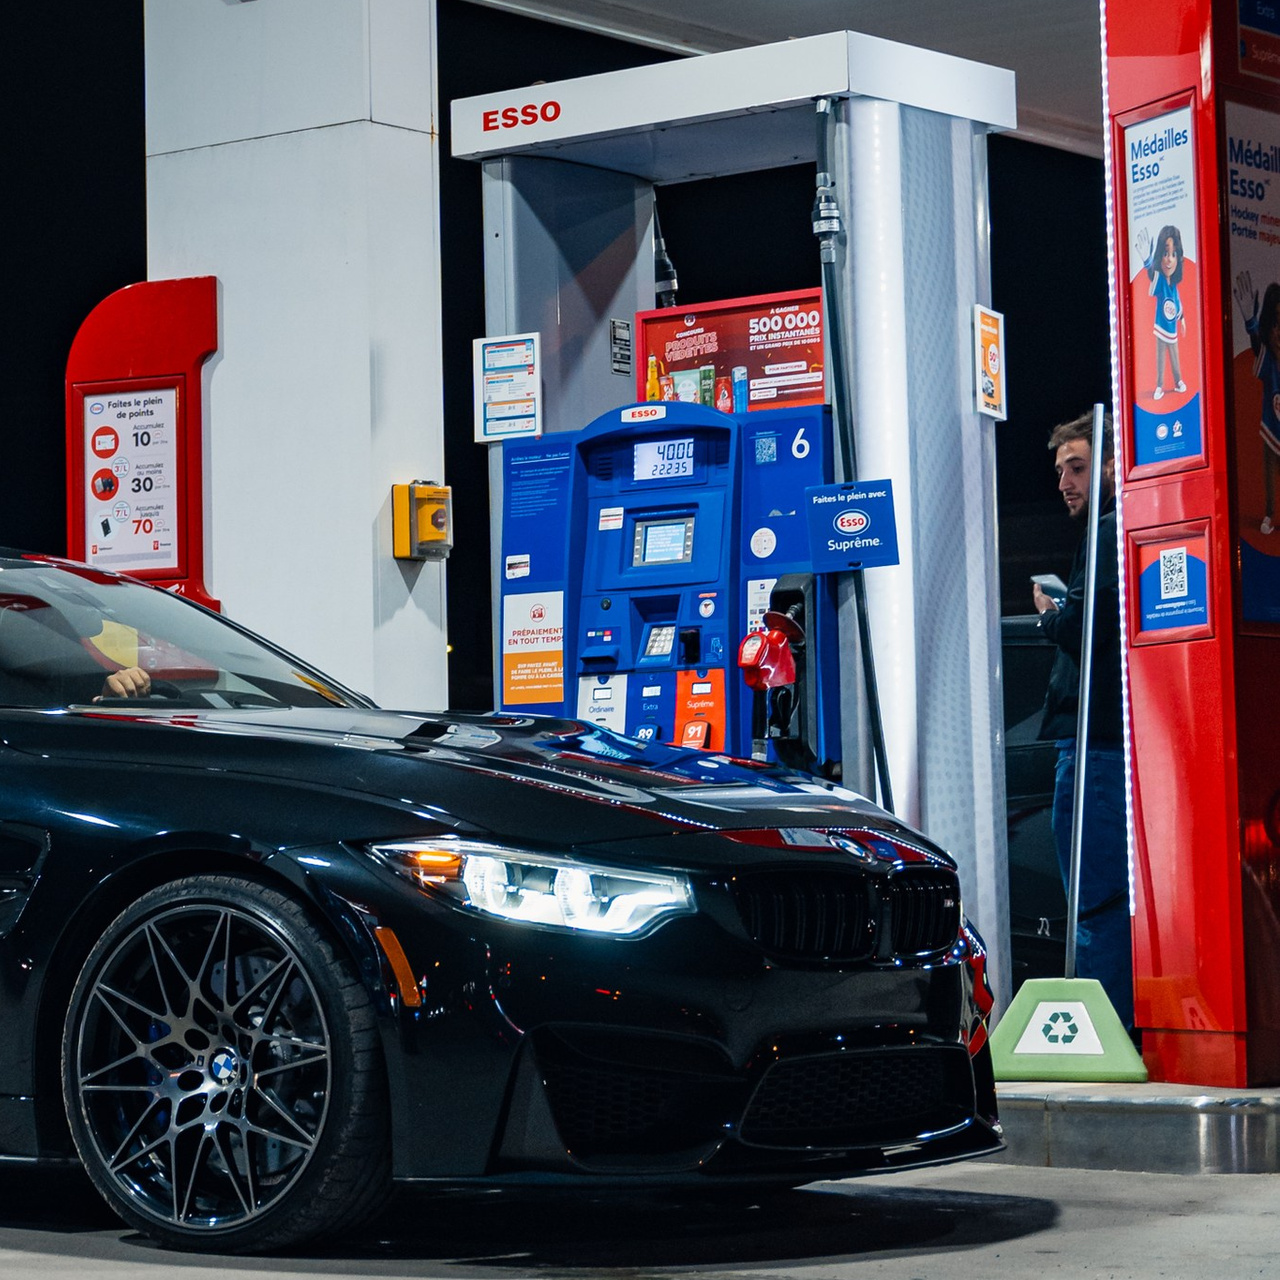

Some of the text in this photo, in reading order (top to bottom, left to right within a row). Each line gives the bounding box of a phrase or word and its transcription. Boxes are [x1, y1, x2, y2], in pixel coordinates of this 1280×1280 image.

[482, 100, 562, 132] ESSO
[1130, 127, 1189, 162] Médailles
[1132, 162, 1160, 184] Esso
[1230, 169, 1265, 202] Esso
[1230, 204, 1259, 226] Hockey
[1231, 222, 1258, 241] Portée
[749, 310, 820, 334] 500 000
[665, 332, 718, 353] PRODUITS
[749, 326, 820, 343] PRIX INSTANTANÉS
[664, 342, 719, 363] VEDETTES
[108, 400, 132, 409] Faites
[143, 396, 163, 407] plein
[116, 409, 154, 420] de points
[631, 409, 657, 418] ESSO
[133, 422, 164, 430] Accumulez
[132, 431, 151, 447] 10
[791, 428, 810, 459] 6
[657, 441, 694, 461] 40.00
[652, 462, 687, 476] 22.235
[131, 476, 153, 493] 30
[812, 495, 836, 504] Faites
[847, 492, 867, 503] plein
[868, 490, 886, 498] avec
[132, 519, 153, 535] 70
[840, 517, 864, 527] Esso
[827, 537, 880, 552] Suprême
[512, 627, 563, 637] PRÉPAIEMENT
[520, 636, 540, 645] TOUT
[588, 705, 614, 713] Ordinaire
[687, 700, 714, 709] Suprême
[638, 728, 653, 739] 89
[688, 726, 702, 738] 91
